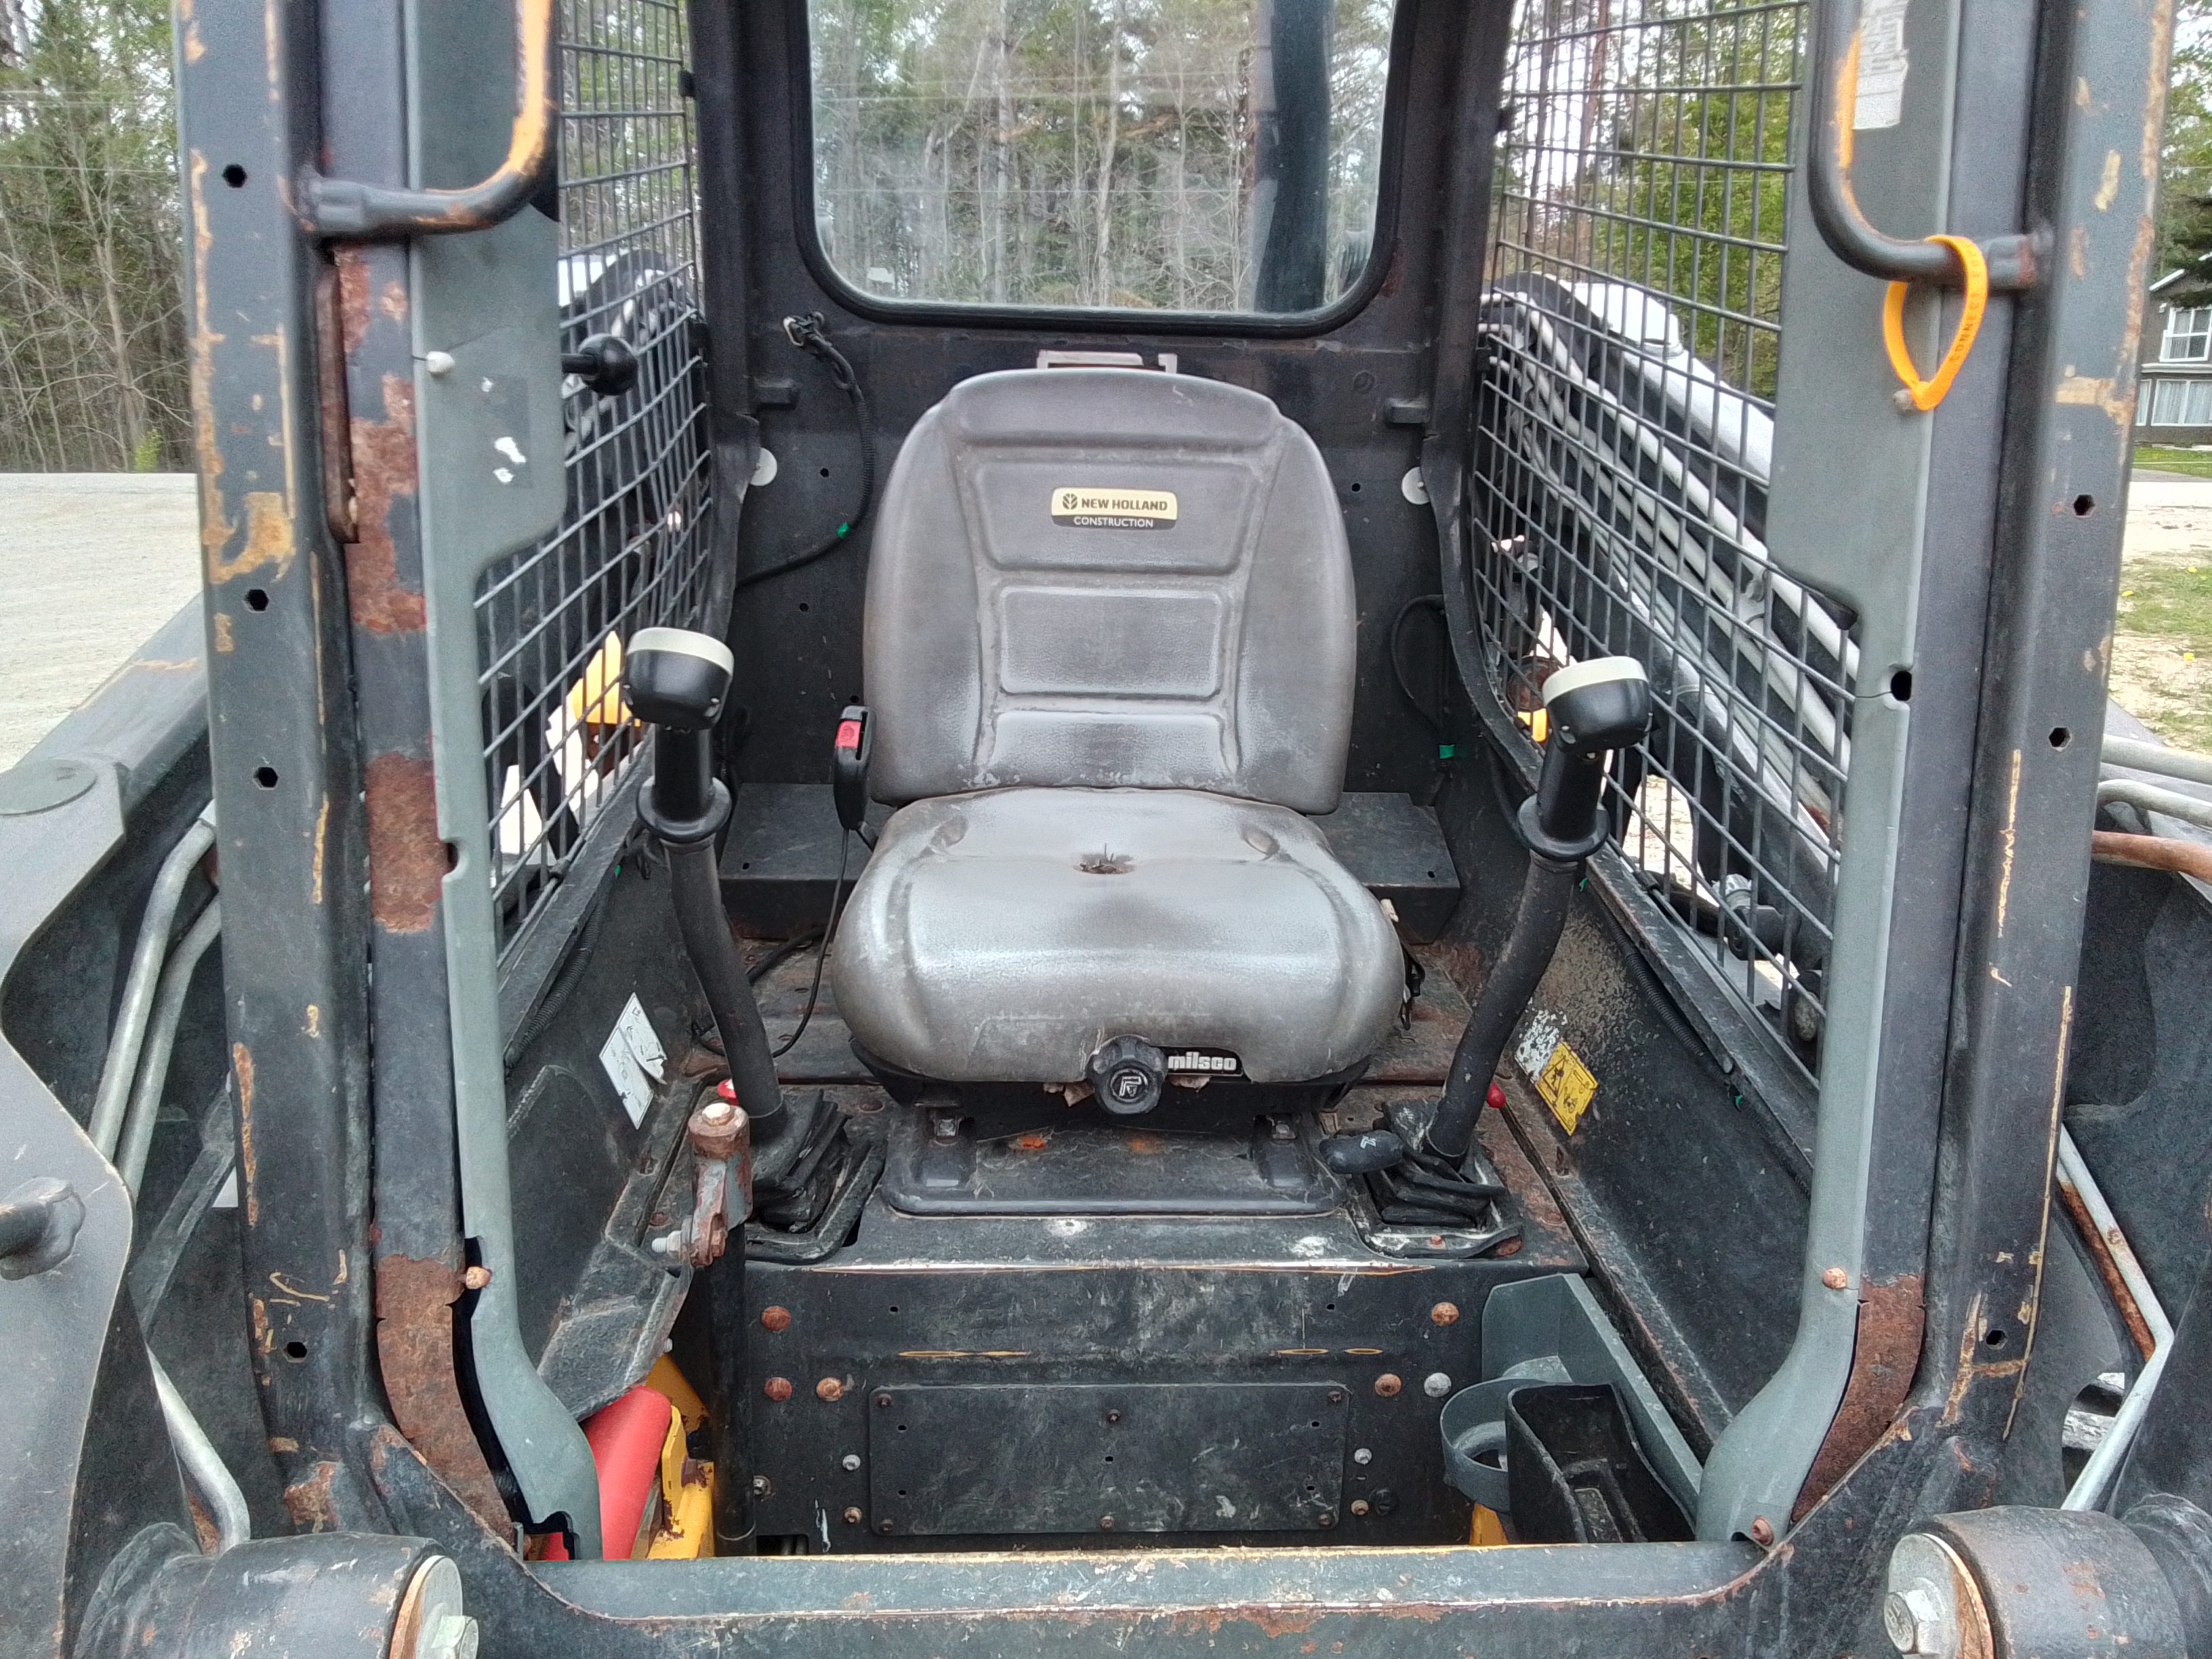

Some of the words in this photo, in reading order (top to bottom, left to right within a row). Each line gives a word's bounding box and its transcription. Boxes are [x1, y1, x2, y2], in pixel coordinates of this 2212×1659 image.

[1081, 497, 1109, 510] NEW
[1111, 499, 1168, 511] HOLLAND
[1073, 516, 1153, 528] CONSTRUCTION
[1168, 1051, 1237, 1071] milsco
